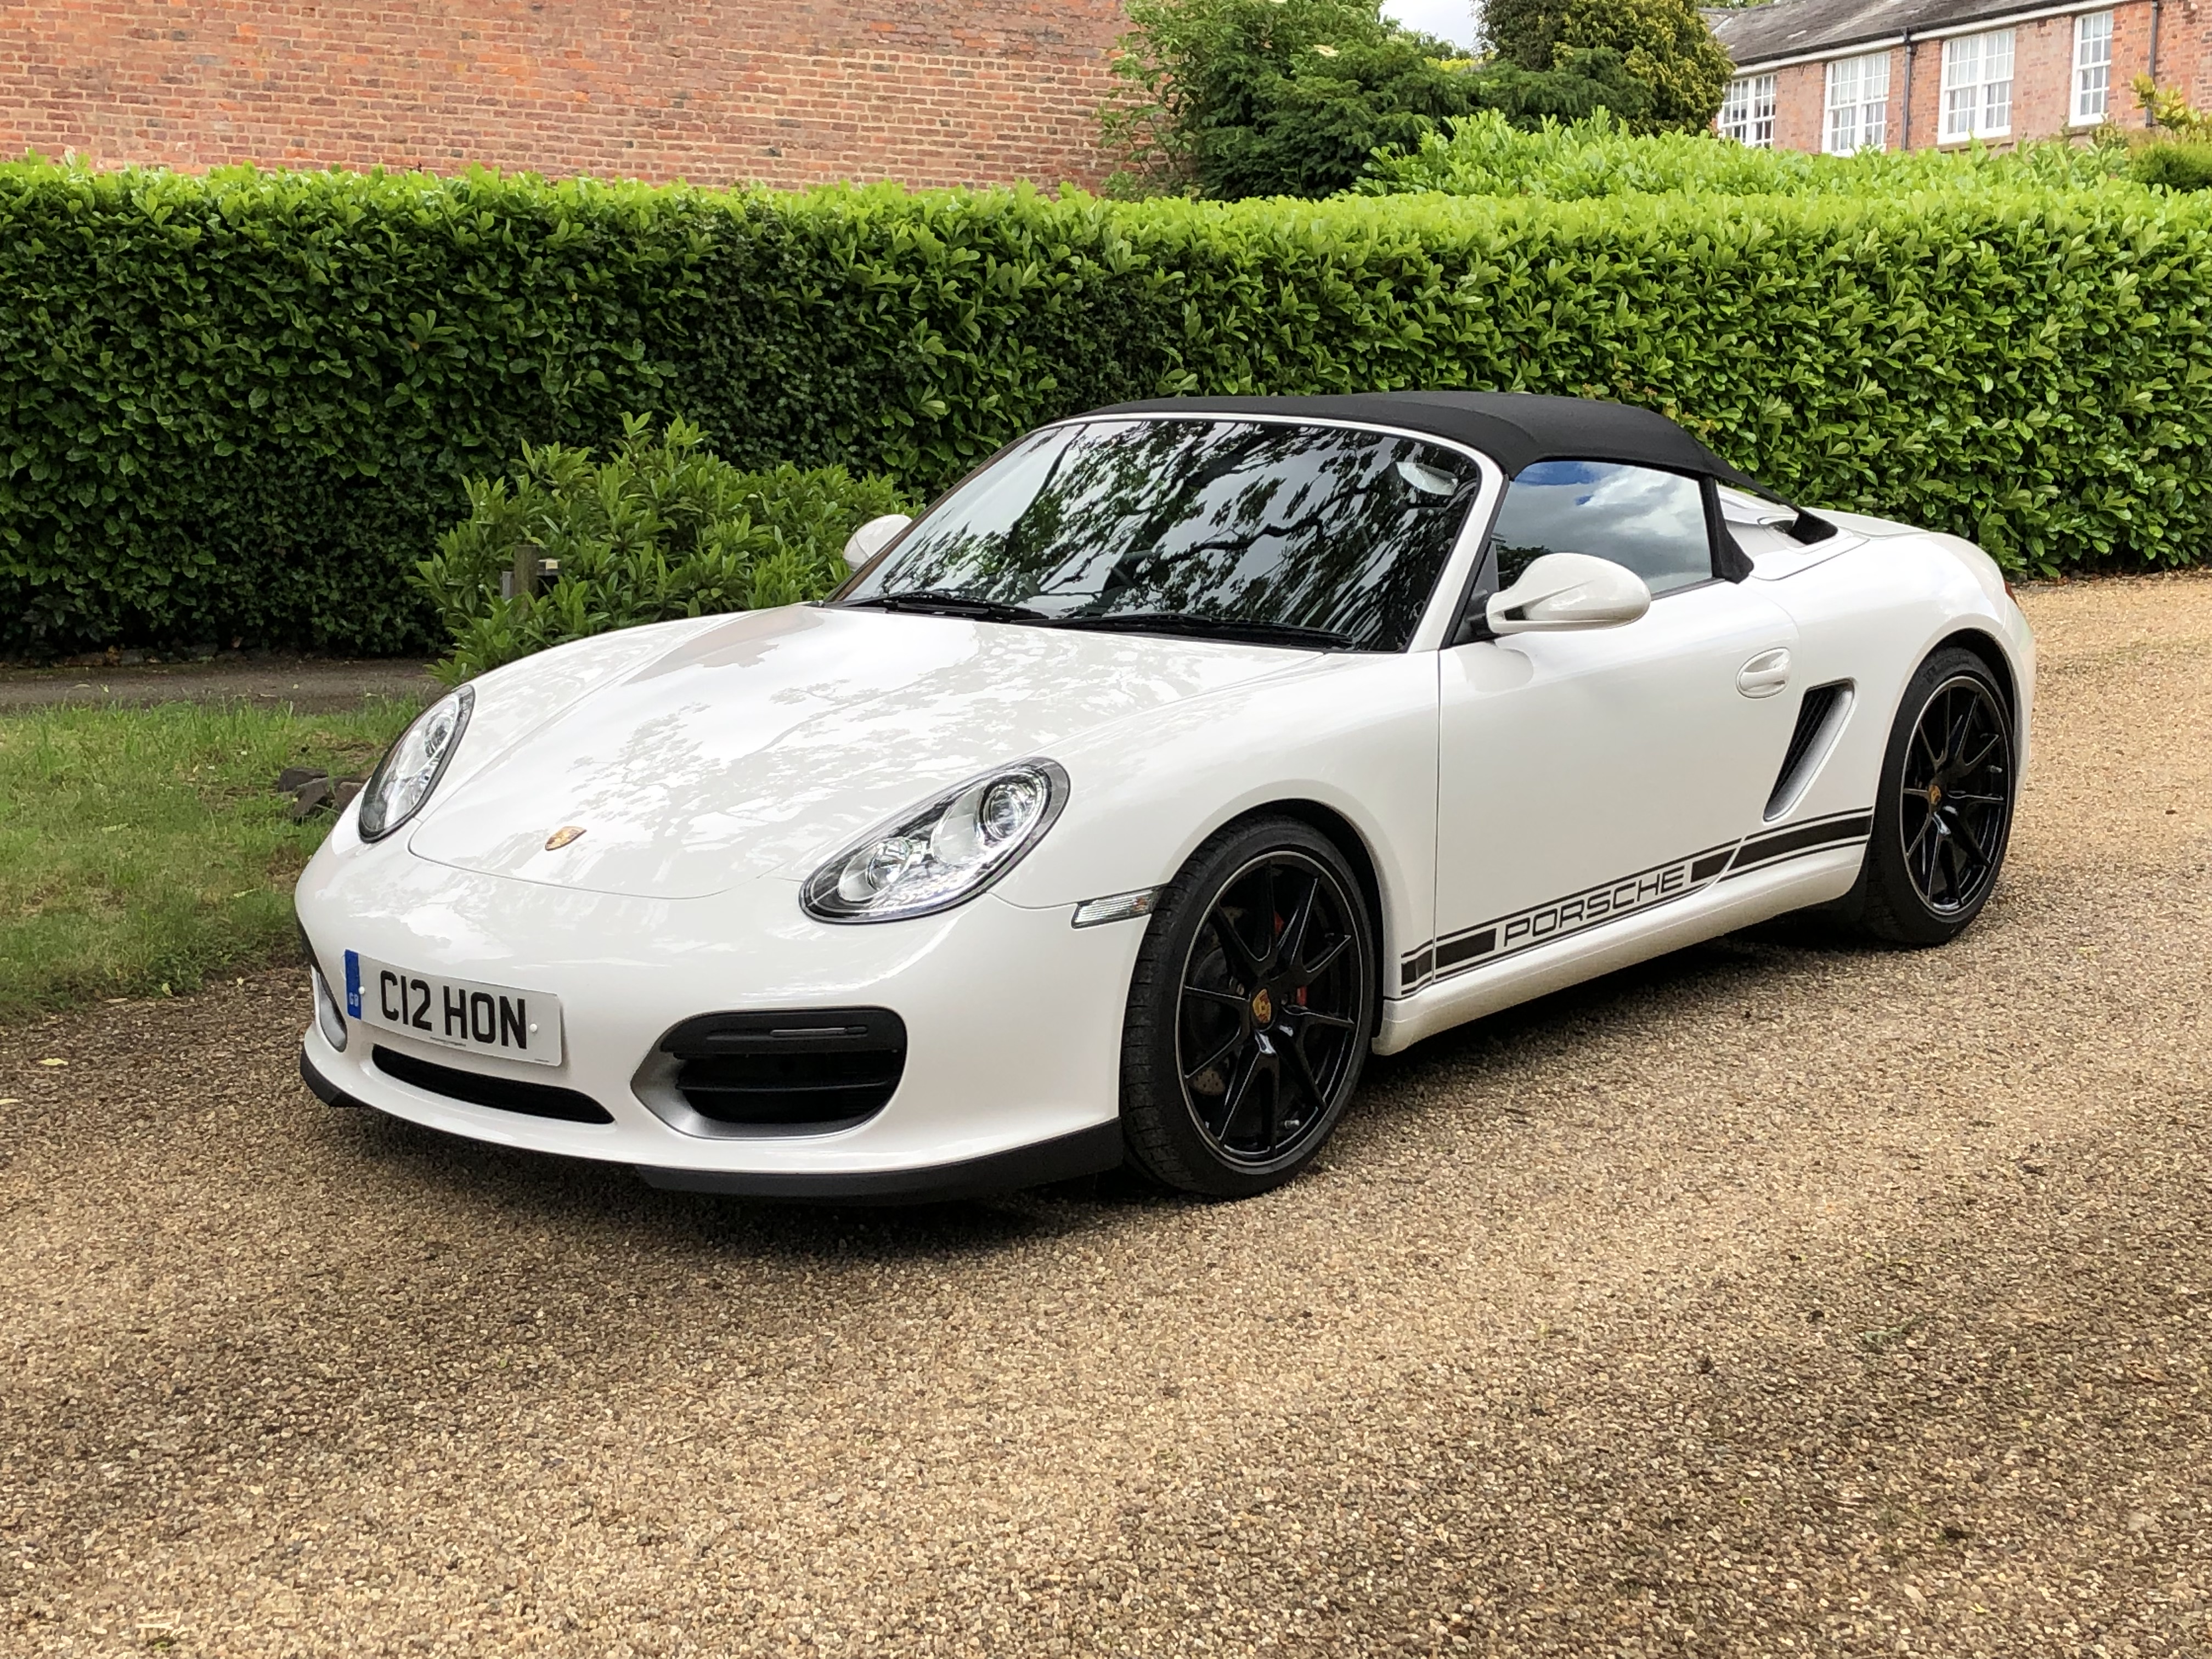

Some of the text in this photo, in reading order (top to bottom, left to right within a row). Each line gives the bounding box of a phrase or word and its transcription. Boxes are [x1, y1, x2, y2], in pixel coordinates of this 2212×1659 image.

[1504, 865, 1685, 947] PORSCHE
[380, 970, 527, 1050] C12 HON
